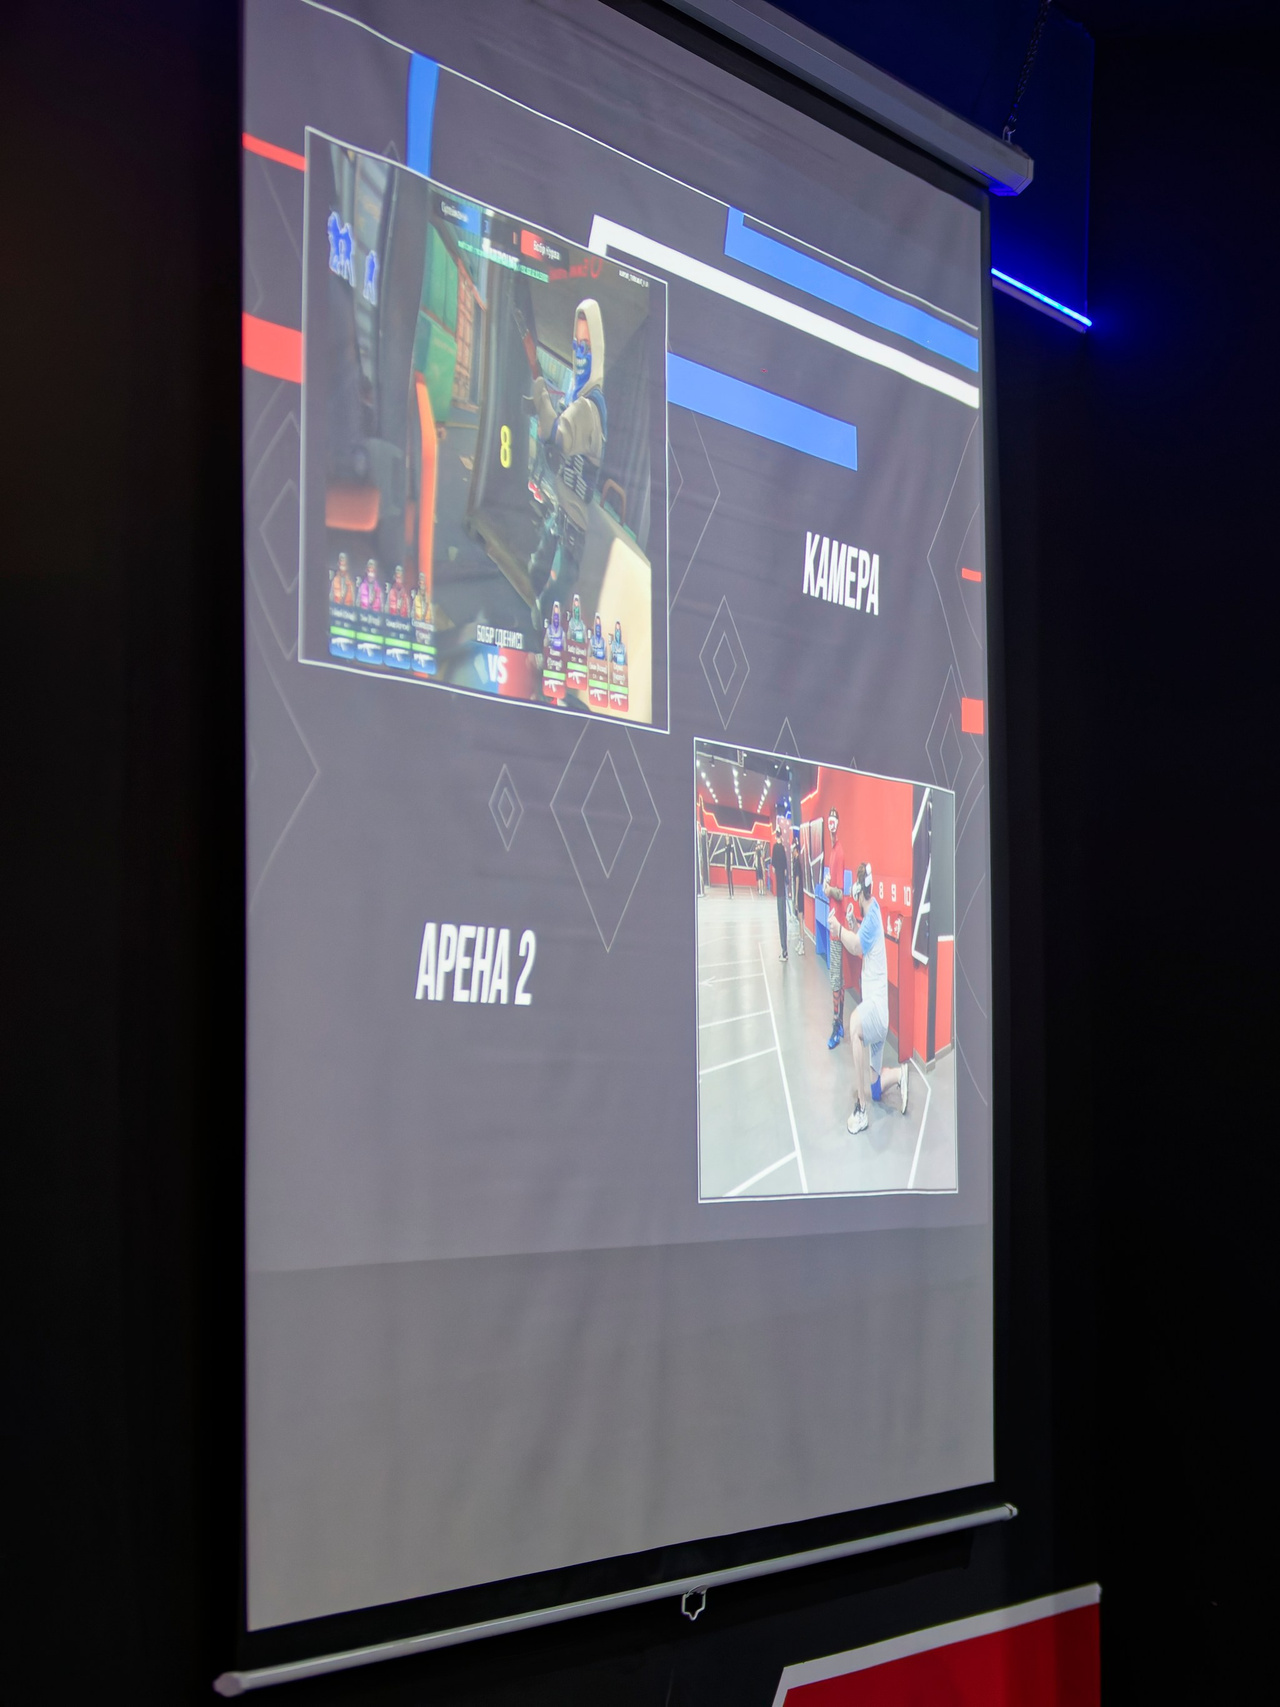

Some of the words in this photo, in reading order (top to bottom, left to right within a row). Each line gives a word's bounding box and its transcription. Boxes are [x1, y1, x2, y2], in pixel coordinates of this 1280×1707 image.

[500, 425, 511, 468] 8
[802, 531, 880, 616] КАМЕРА
[476, 624, 495, 644] БОБР
[487, 653, 508, 684] VS
[878, 881, 884, 900] 8
[890, 883, 897, 903] 9
[903, 885, 912, 907] 10
[415, 922, 510, 1005] АРЕНА
[514, 929, 537, 1006] 2
